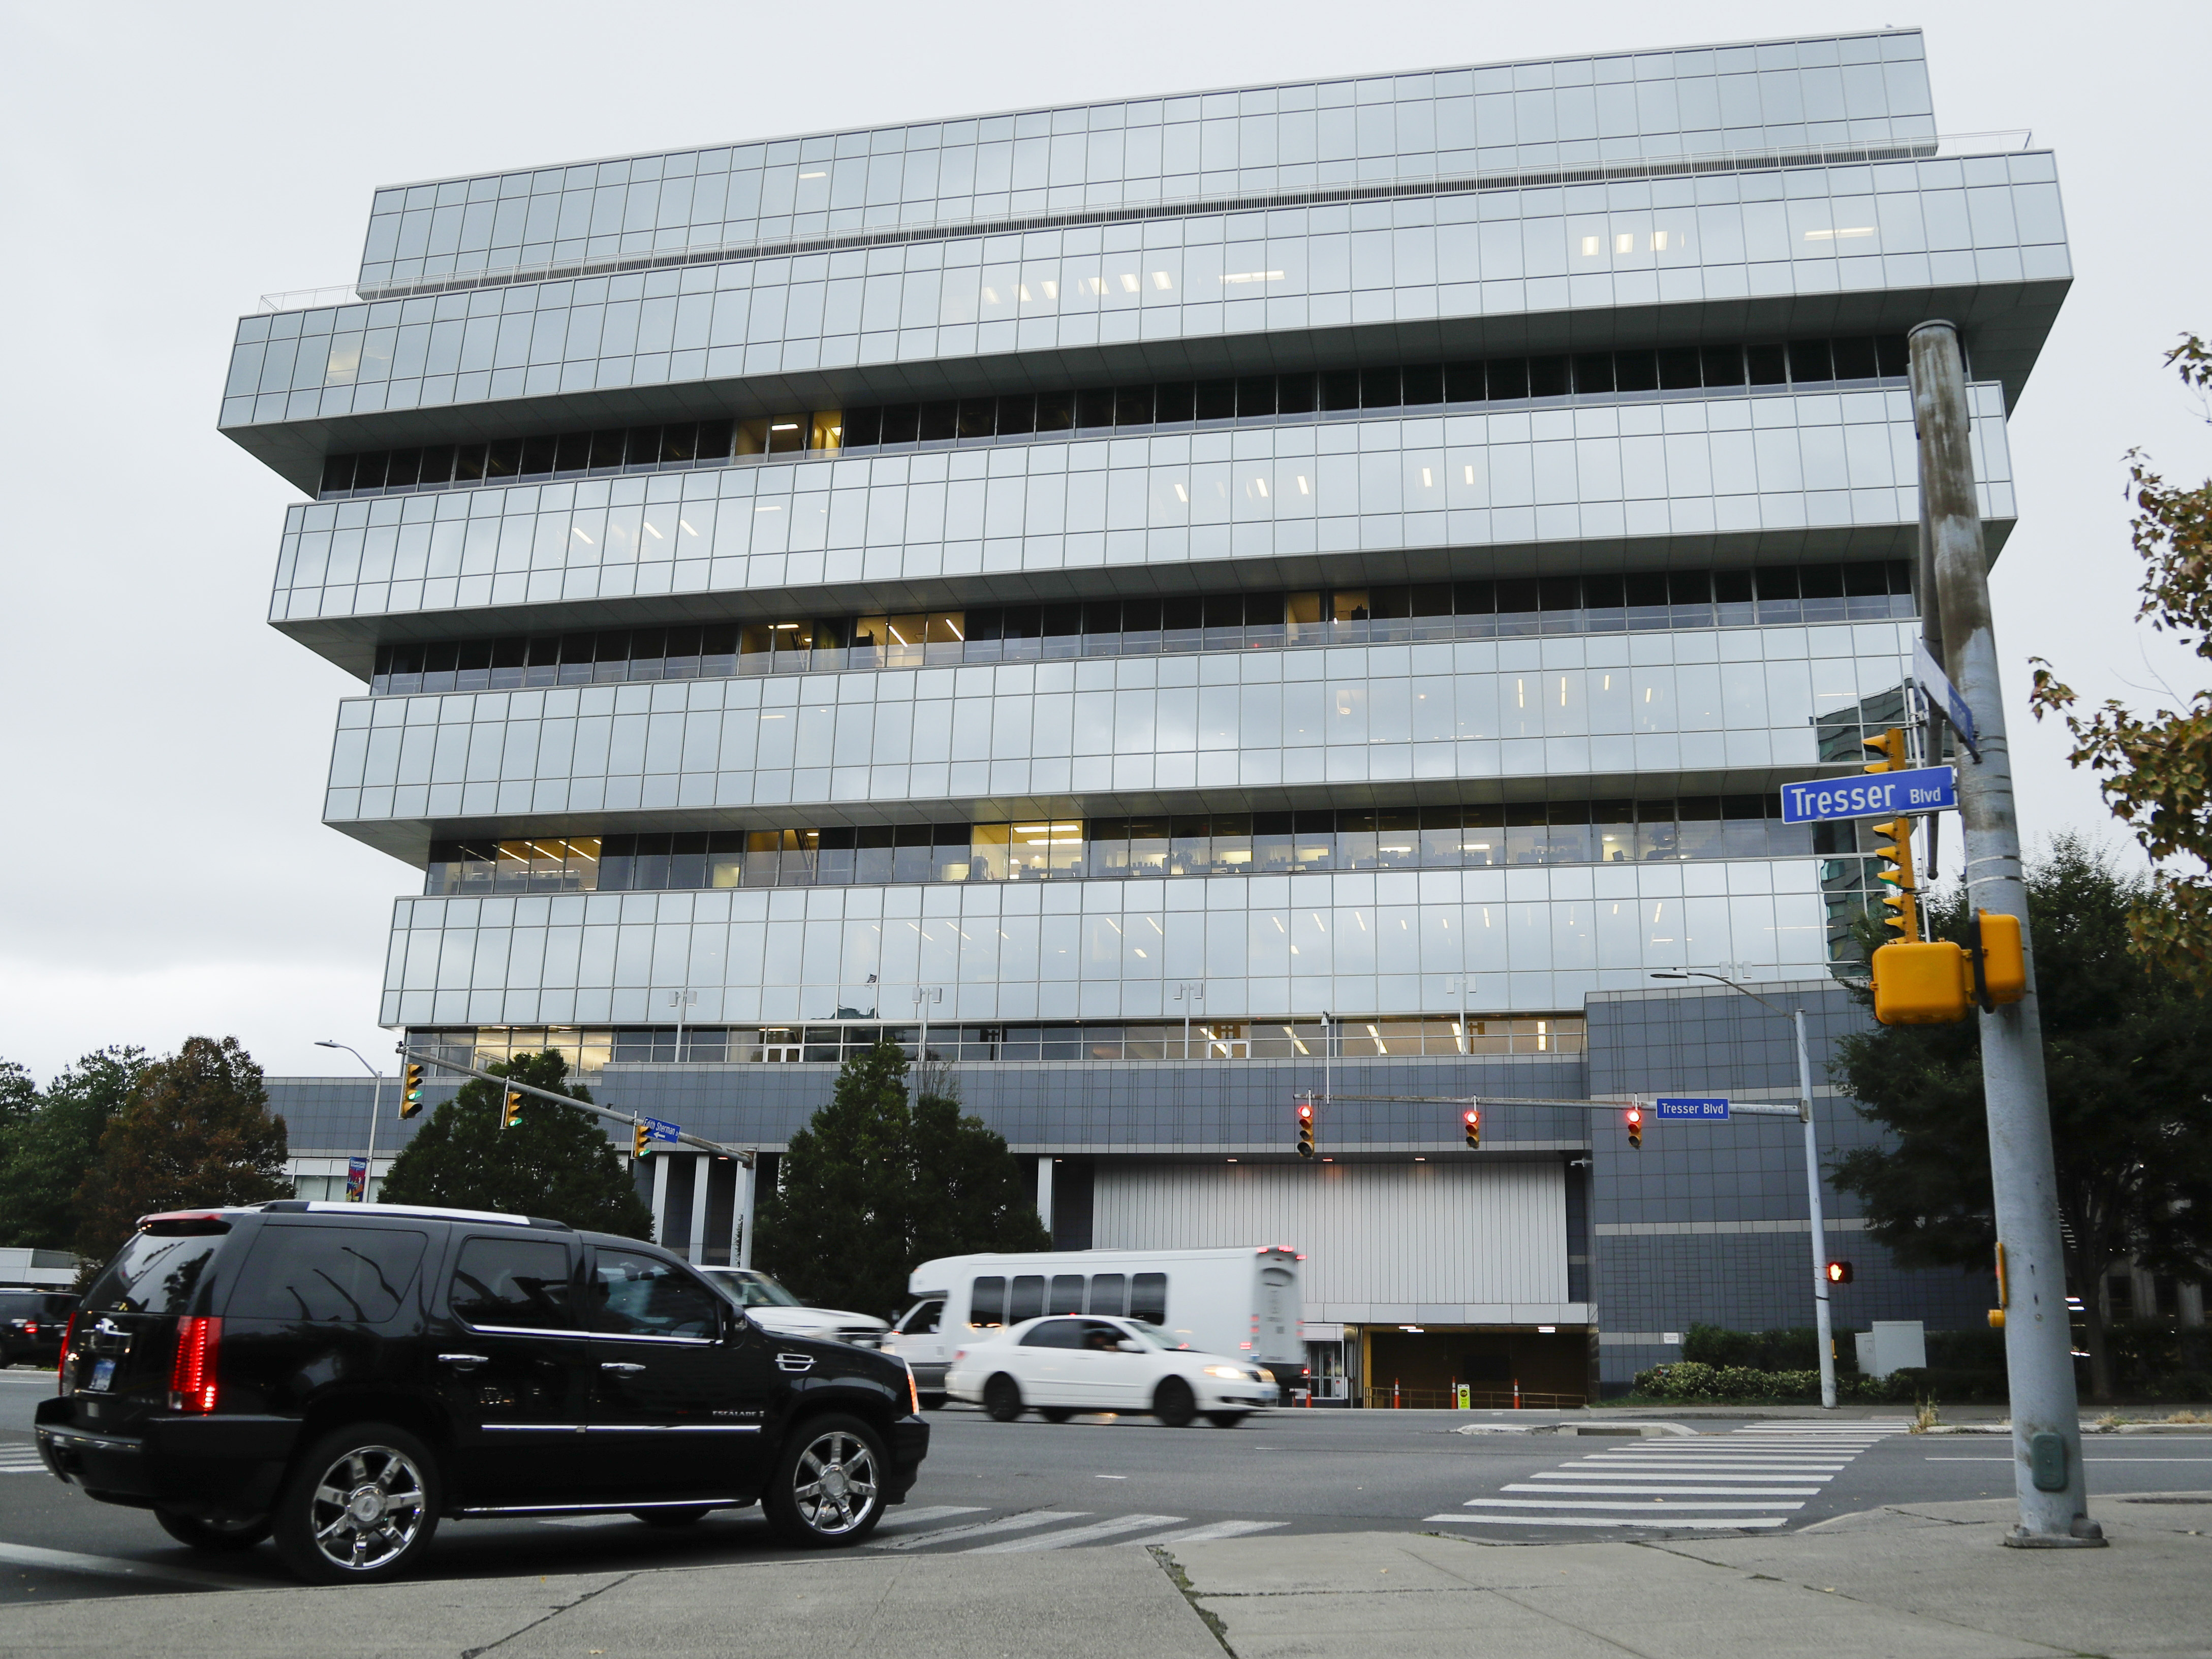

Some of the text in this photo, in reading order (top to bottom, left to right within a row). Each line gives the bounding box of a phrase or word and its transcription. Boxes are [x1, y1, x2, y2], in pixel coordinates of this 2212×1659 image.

[1791, 784, 1941, 817] Tresser Blvd
[1662, 1103, 1723, 1114] Tresser Blvd
[656, 1122, 675, 1136] Sherman
